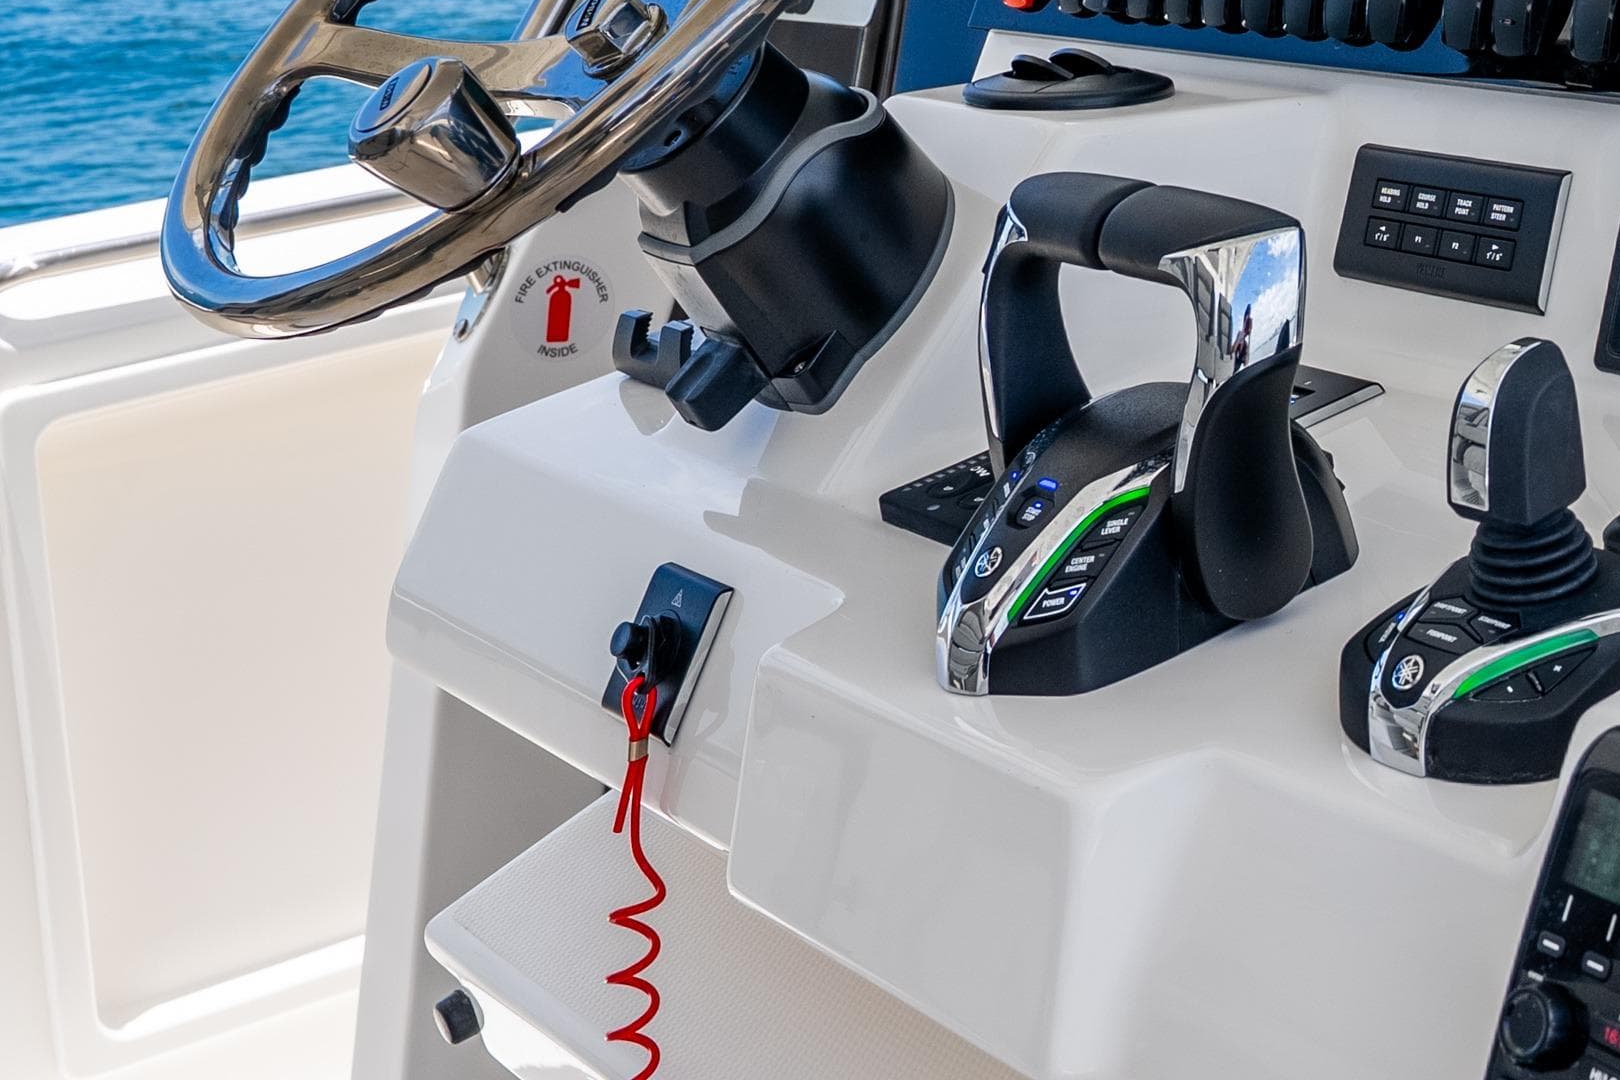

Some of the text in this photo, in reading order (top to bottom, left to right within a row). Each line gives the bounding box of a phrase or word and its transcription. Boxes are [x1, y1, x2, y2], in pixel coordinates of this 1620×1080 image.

[1418, 192, 1436, 202] COURSE
[1416, 202, 1429, 210] HOLD
[1456, 198, 1472, 208] TRACK
[1454, 207, 1470, 216] POINT
[1492, 204, 1514, 214] PATTERN
[1490, 212, 1506, 222] STEER
[1452, 242, 1460, 250] F2
[514, 260, 609, 304] FIRE EXTINGUISHER
[537, 343, 578, 358] INSIDE
[1106, 518, 1128, 528] SINGLE
[1101, 526, 1120, 536] LEVER
[1071, 556, 1095, 565] CENTER
[1065, 564, 1088, 573] ENGINE
[1042, 597, 1064, 608] POWER
